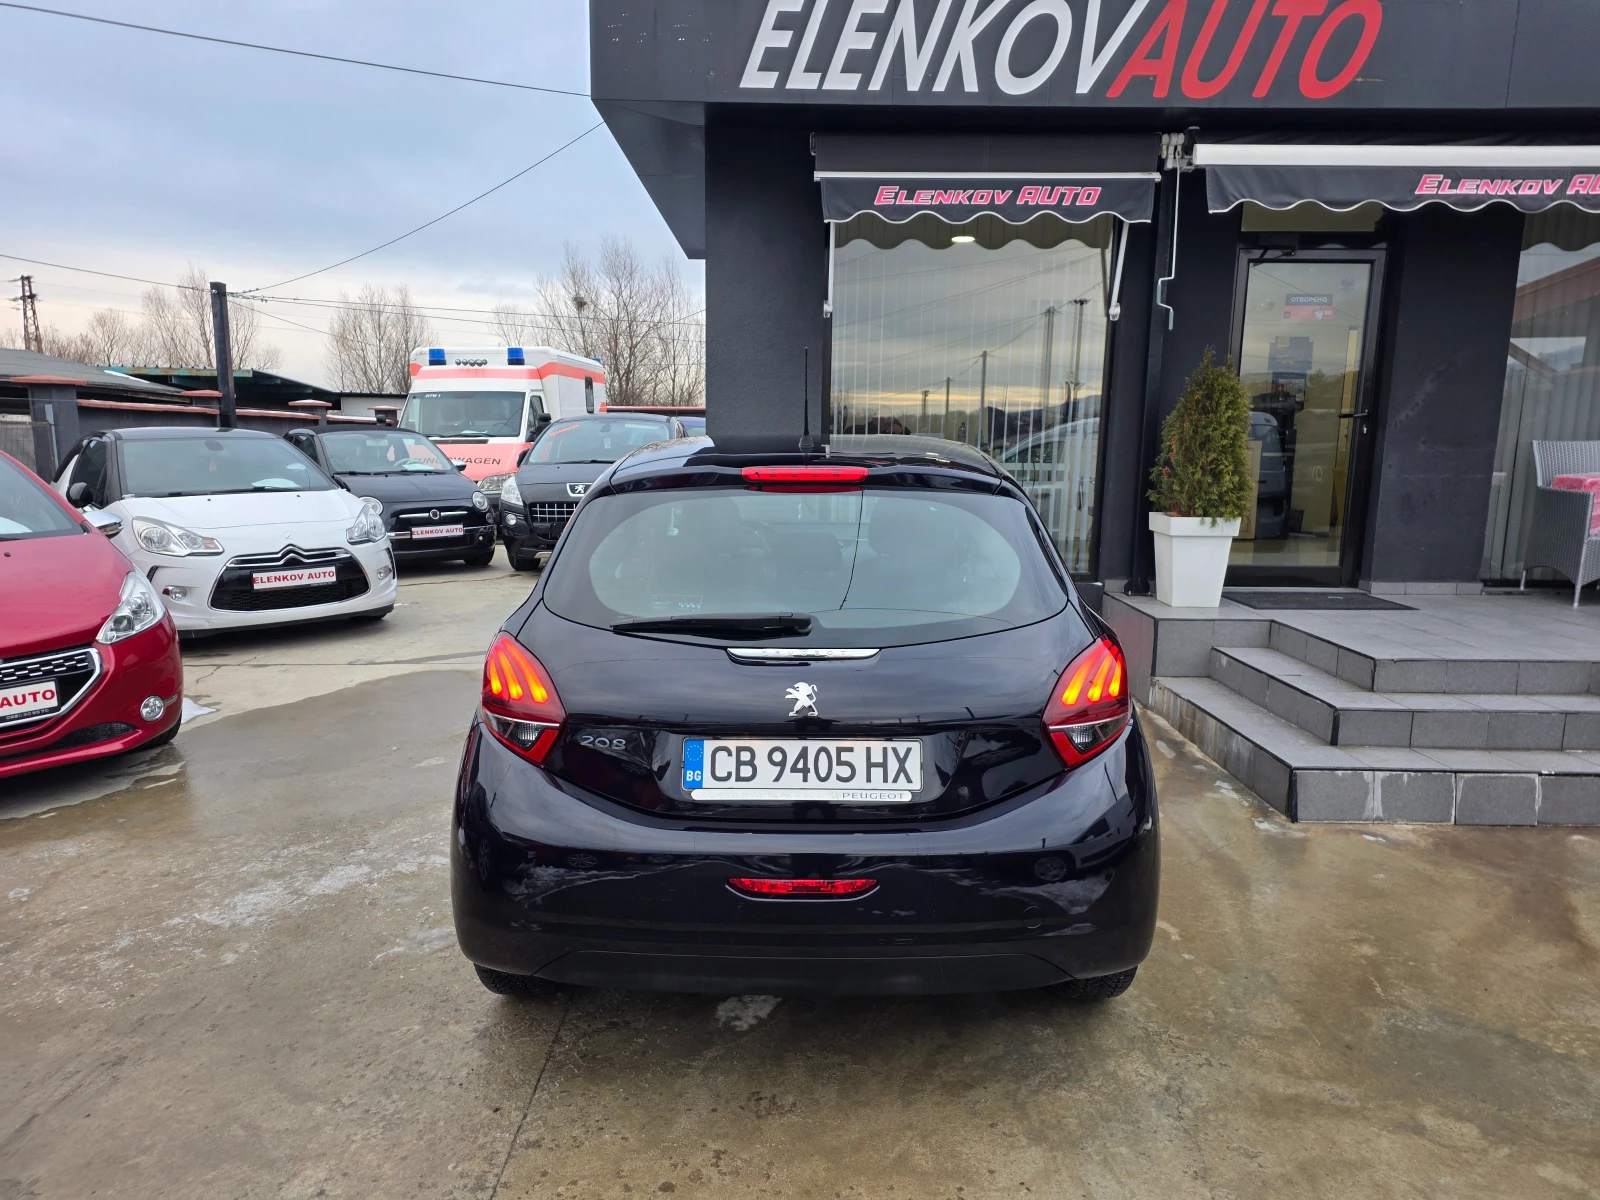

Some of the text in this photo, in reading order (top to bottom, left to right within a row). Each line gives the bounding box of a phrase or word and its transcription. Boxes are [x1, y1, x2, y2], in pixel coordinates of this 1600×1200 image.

[739, 0, 1383, 99] ELENKOV AUTO
[1415, 174, 1563, 195] ELENKOV
[874, 186, 1102, 206] ELENKOV AUTO
[253, 574, 303, 584] ELENKOV
[307, 571, 334, 580] AUTO
[0, 689, 56, 708] AUTO
[580, 735, 626, 750] 208
[710, 745, 914, 784] CB 9405 HX
[685, 770, 702, 782] BG
[842, 791, 905, 800] PEUGEOT
